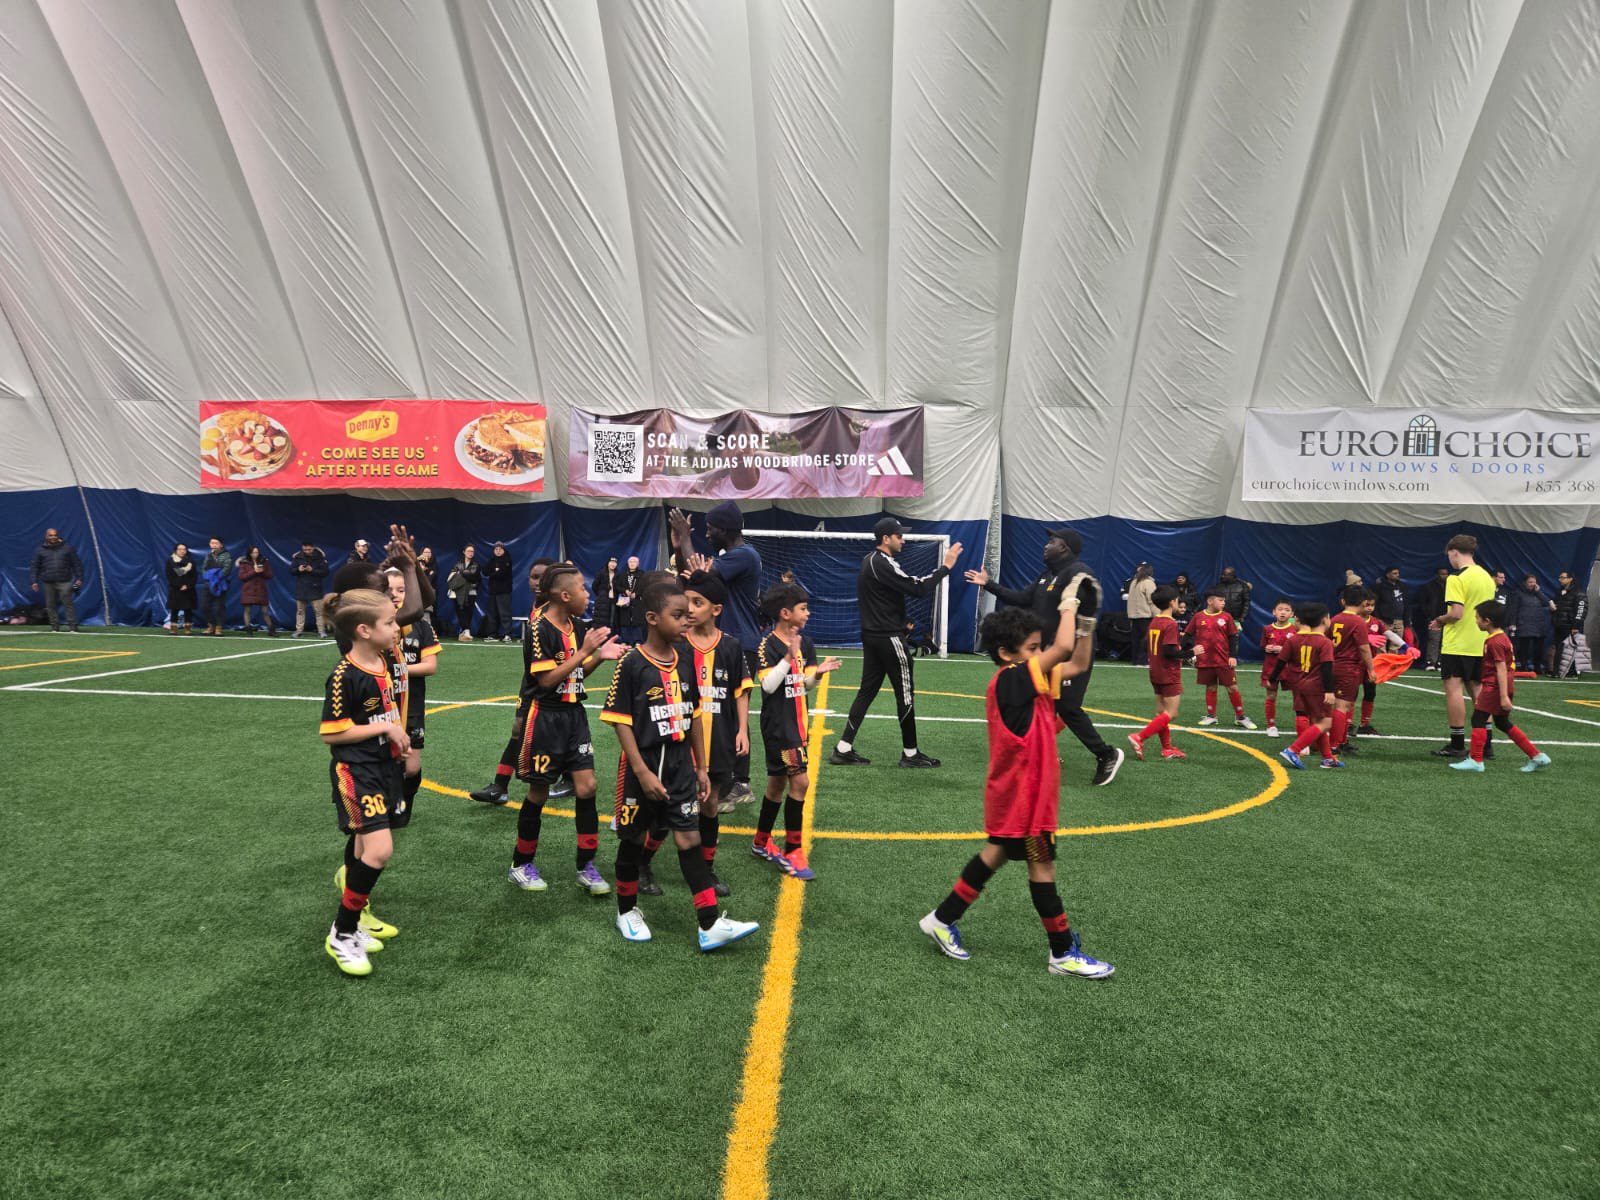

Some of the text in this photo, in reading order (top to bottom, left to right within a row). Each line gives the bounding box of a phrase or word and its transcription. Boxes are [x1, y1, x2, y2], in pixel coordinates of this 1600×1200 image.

[349, 414, 391, 434] Denny's
[647, 433, 771, 450] SCAN & SCORE
[1298, 430, 1593, 458] EURO CHOICE
[321, 447, 425, 459] COME SEE US
[646, 453, 875, 469] AT THE ADIDAS WOODBRIDGE STORE
[306, 463, 439, 477] AFTER THE GAME
[1331, 461, 1546, 474] WINDOWS & DOORS
[1251, 478, 1431, 492] eurochoicewindows.com
[1149, 629, 1161, 656] 17
[1332, 623, 1345, 648] 5
[1300, 646, 1312, 673] 11
[700, 666, 708, 680] 8
[665, 681, 678, 697] 37
[532, 754, 551, 774] 12
[361, 793, 387, 817] 30
[620, 805, 639, 826] 37
